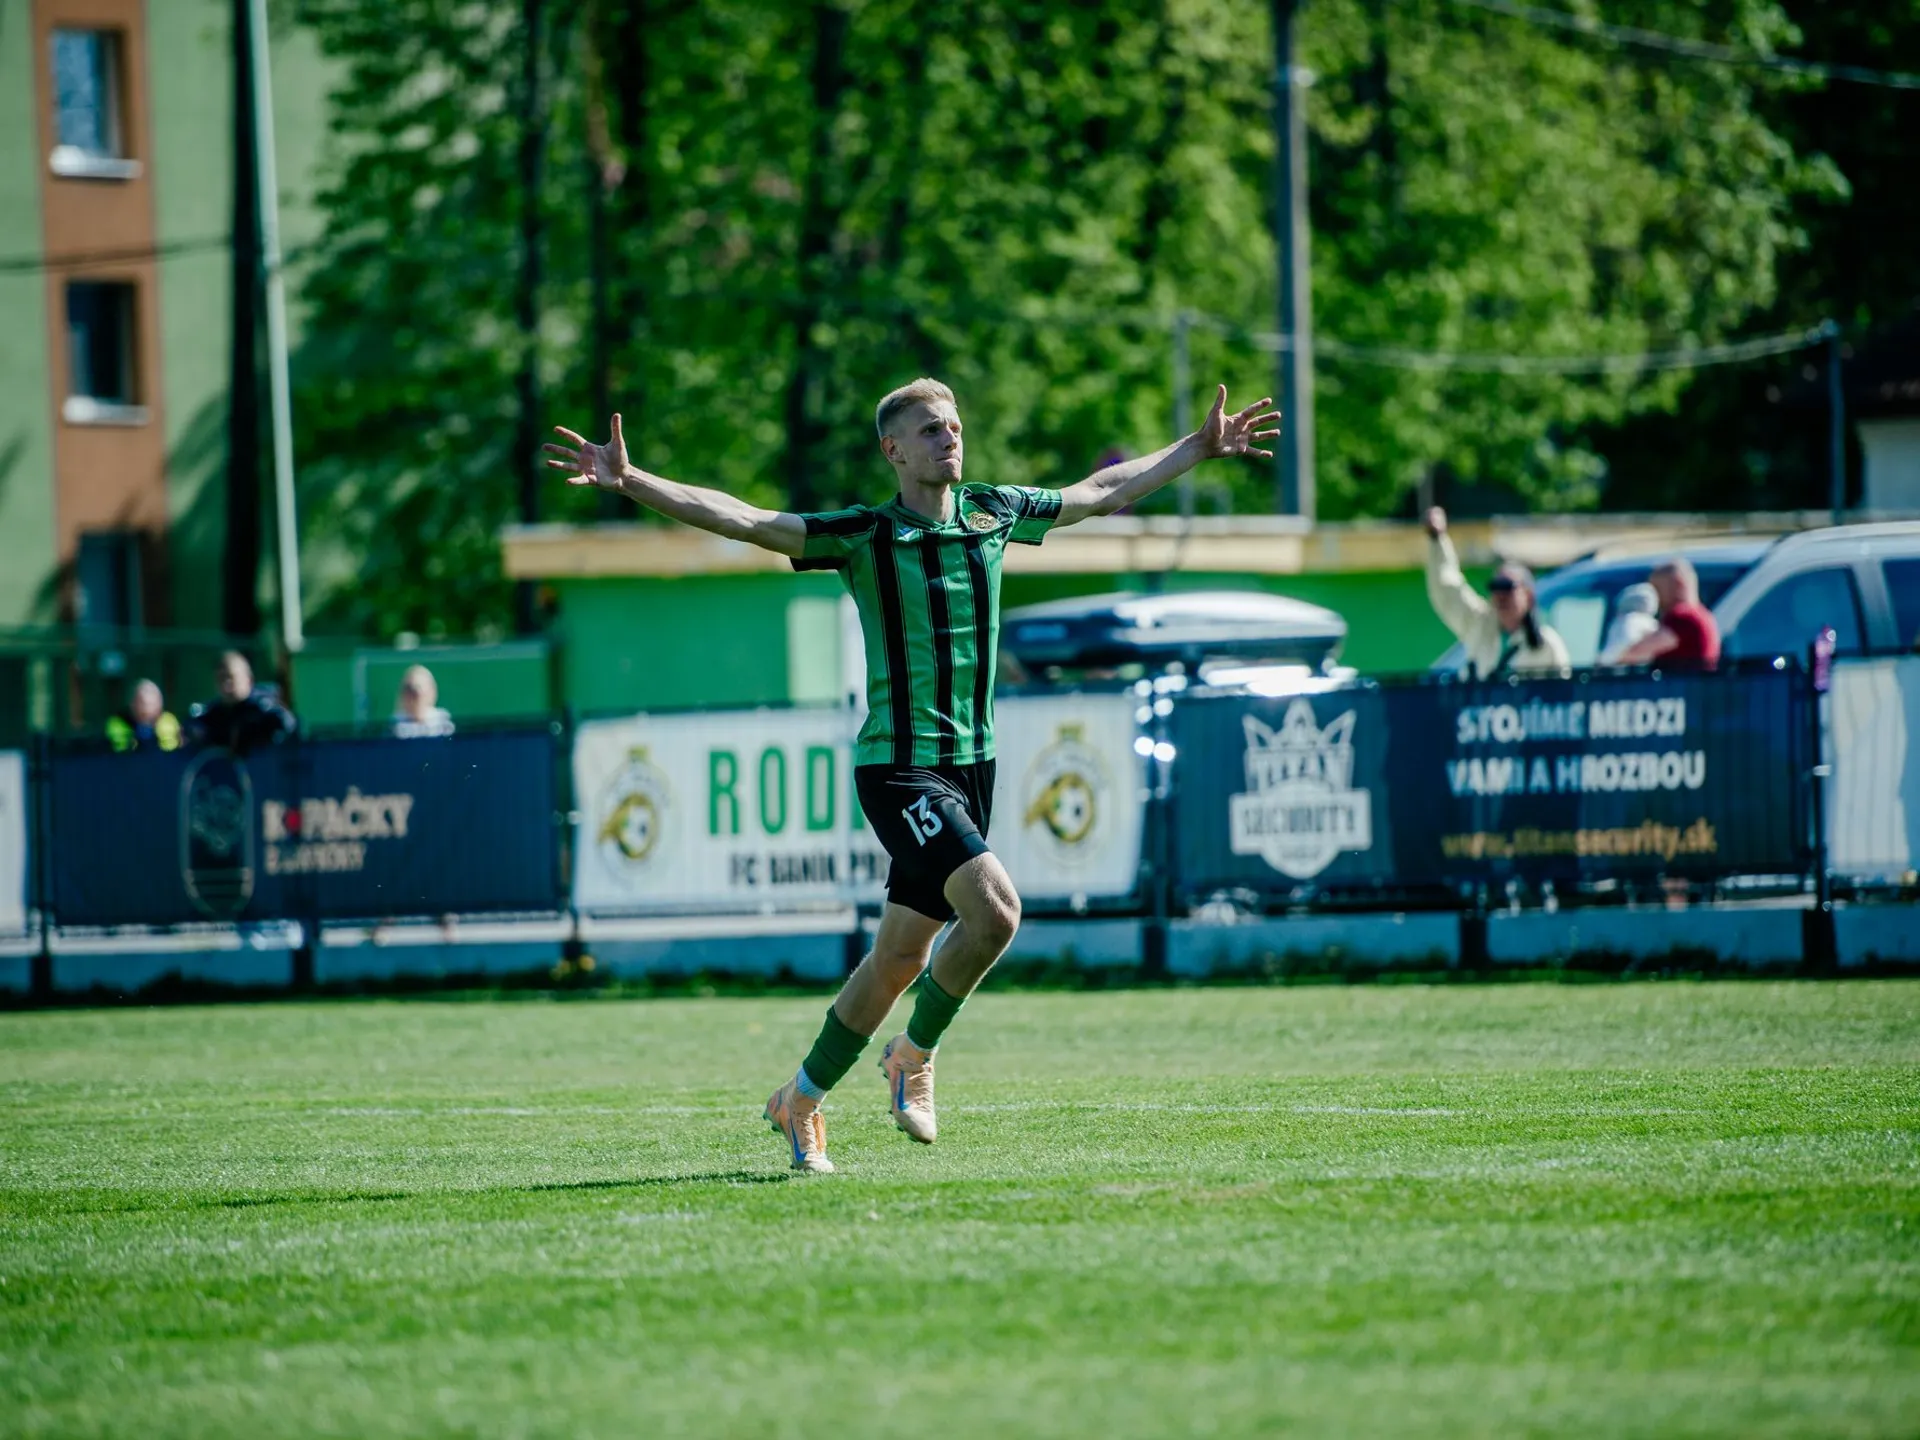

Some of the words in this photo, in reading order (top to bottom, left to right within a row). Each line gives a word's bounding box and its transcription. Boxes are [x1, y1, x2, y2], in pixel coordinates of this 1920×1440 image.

[1457, 697, 1586, 743] STOJÍME
[1588, 698, 1686, 739] MEDZI
[1446, 757, 1525, 797] VAMI
[1529, 756, 1550, 795] A
[1555, 750, 1706, 795] HROZBOU
[901, 794, 943, 847] 13
[1243, 804, 1355, 835] SECURITY
[730, 853, 758, 885] FC
